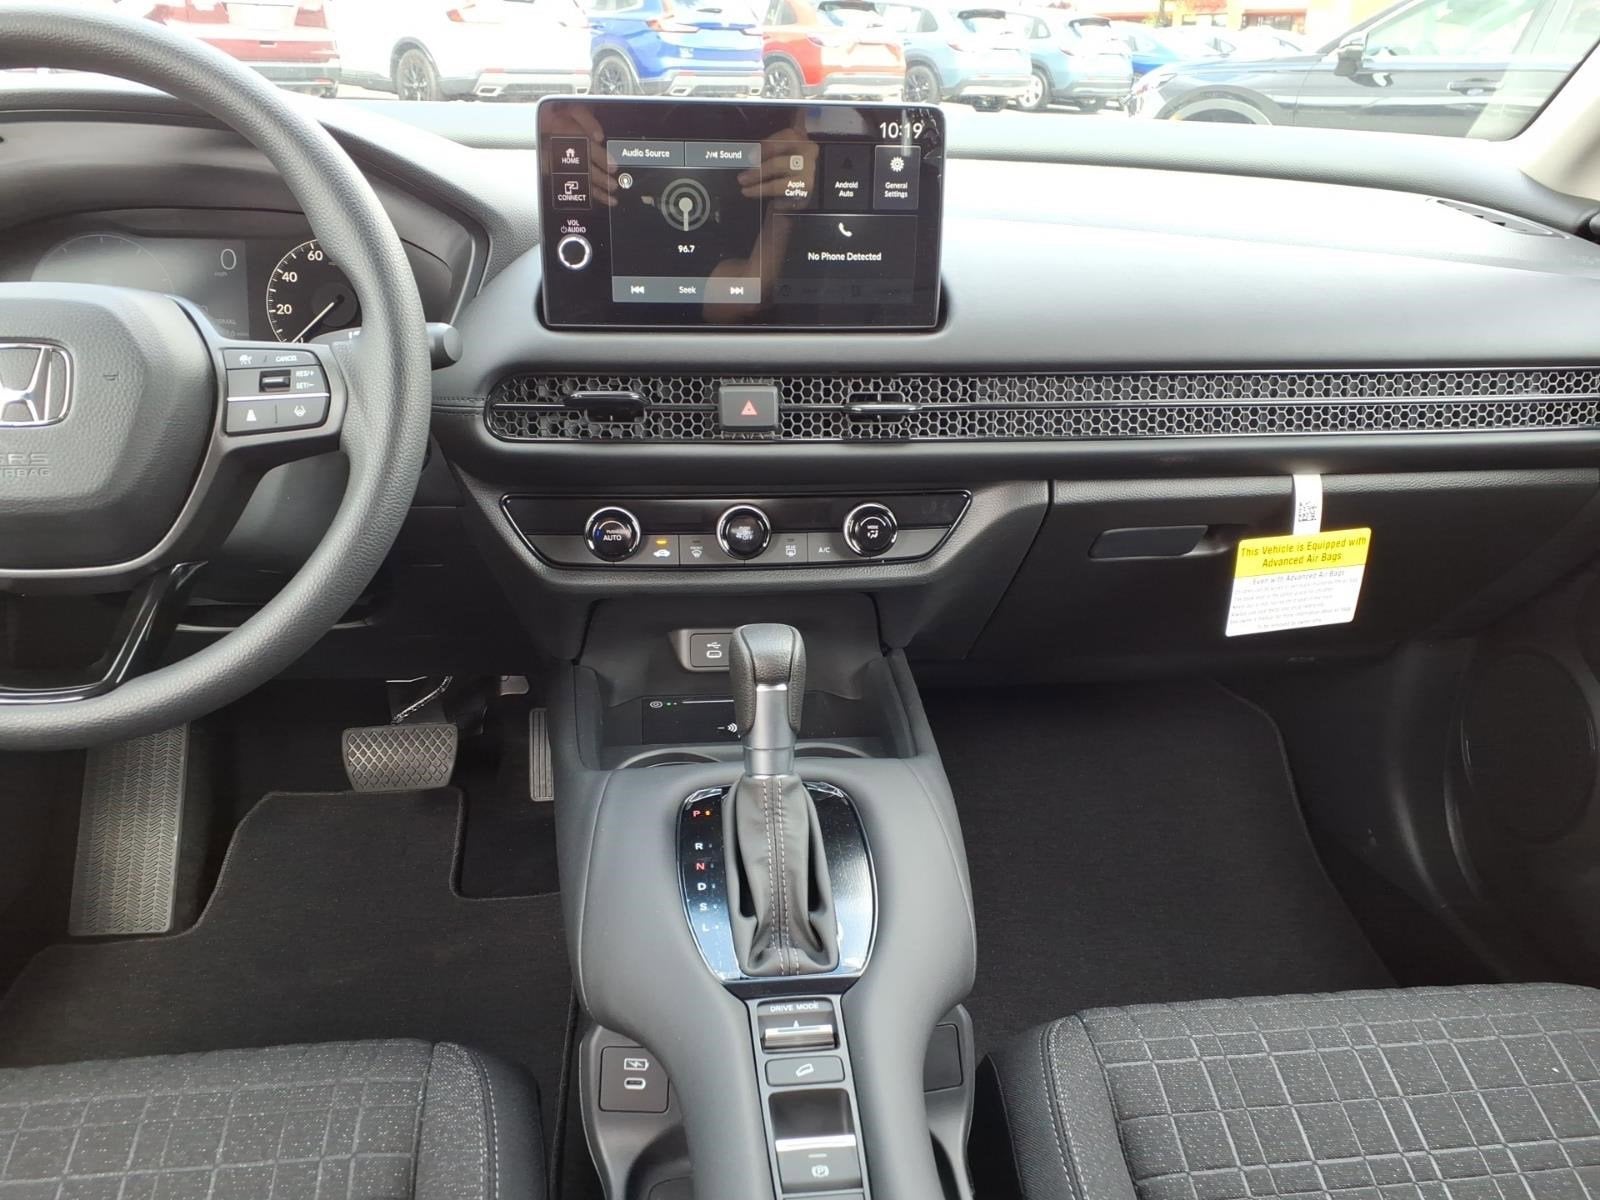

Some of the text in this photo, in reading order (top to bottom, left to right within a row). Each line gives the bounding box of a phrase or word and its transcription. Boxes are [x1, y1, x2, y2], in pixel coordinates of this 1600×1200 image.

[879, 122, 923, 139] 10:19
[621, 149, 670, 158] Audio Source
[719, 151, 742, 159] Sound
[787, 181, 805, 190] Apple
[834, 181, 858, 189] Android
[557, 194, 587, 202] CONNECT
[785, 189, 808, 198] CarPlay
[884, 190, 908, 199] Settings
[677, 245, 695, 253] 96.7
[307, 251, 323, 261] 60
[807, 252, 882, 261] No Phone Detected
[281, 272, 298, 282] 40
[678, 286, 696, 294] Seek
[276, 304, 292, 314] 20
[1241, 536, 1367, 557] This Vehicle is Equipped with
[1262, 552, 1342, 568] Advanced Air Bags
[694, 842, 704, 850] R
[699, 903, 708, 911] S
[702, 924, 710, 932] L
[770, 1001, 819, 1012] DRIVE MODE
